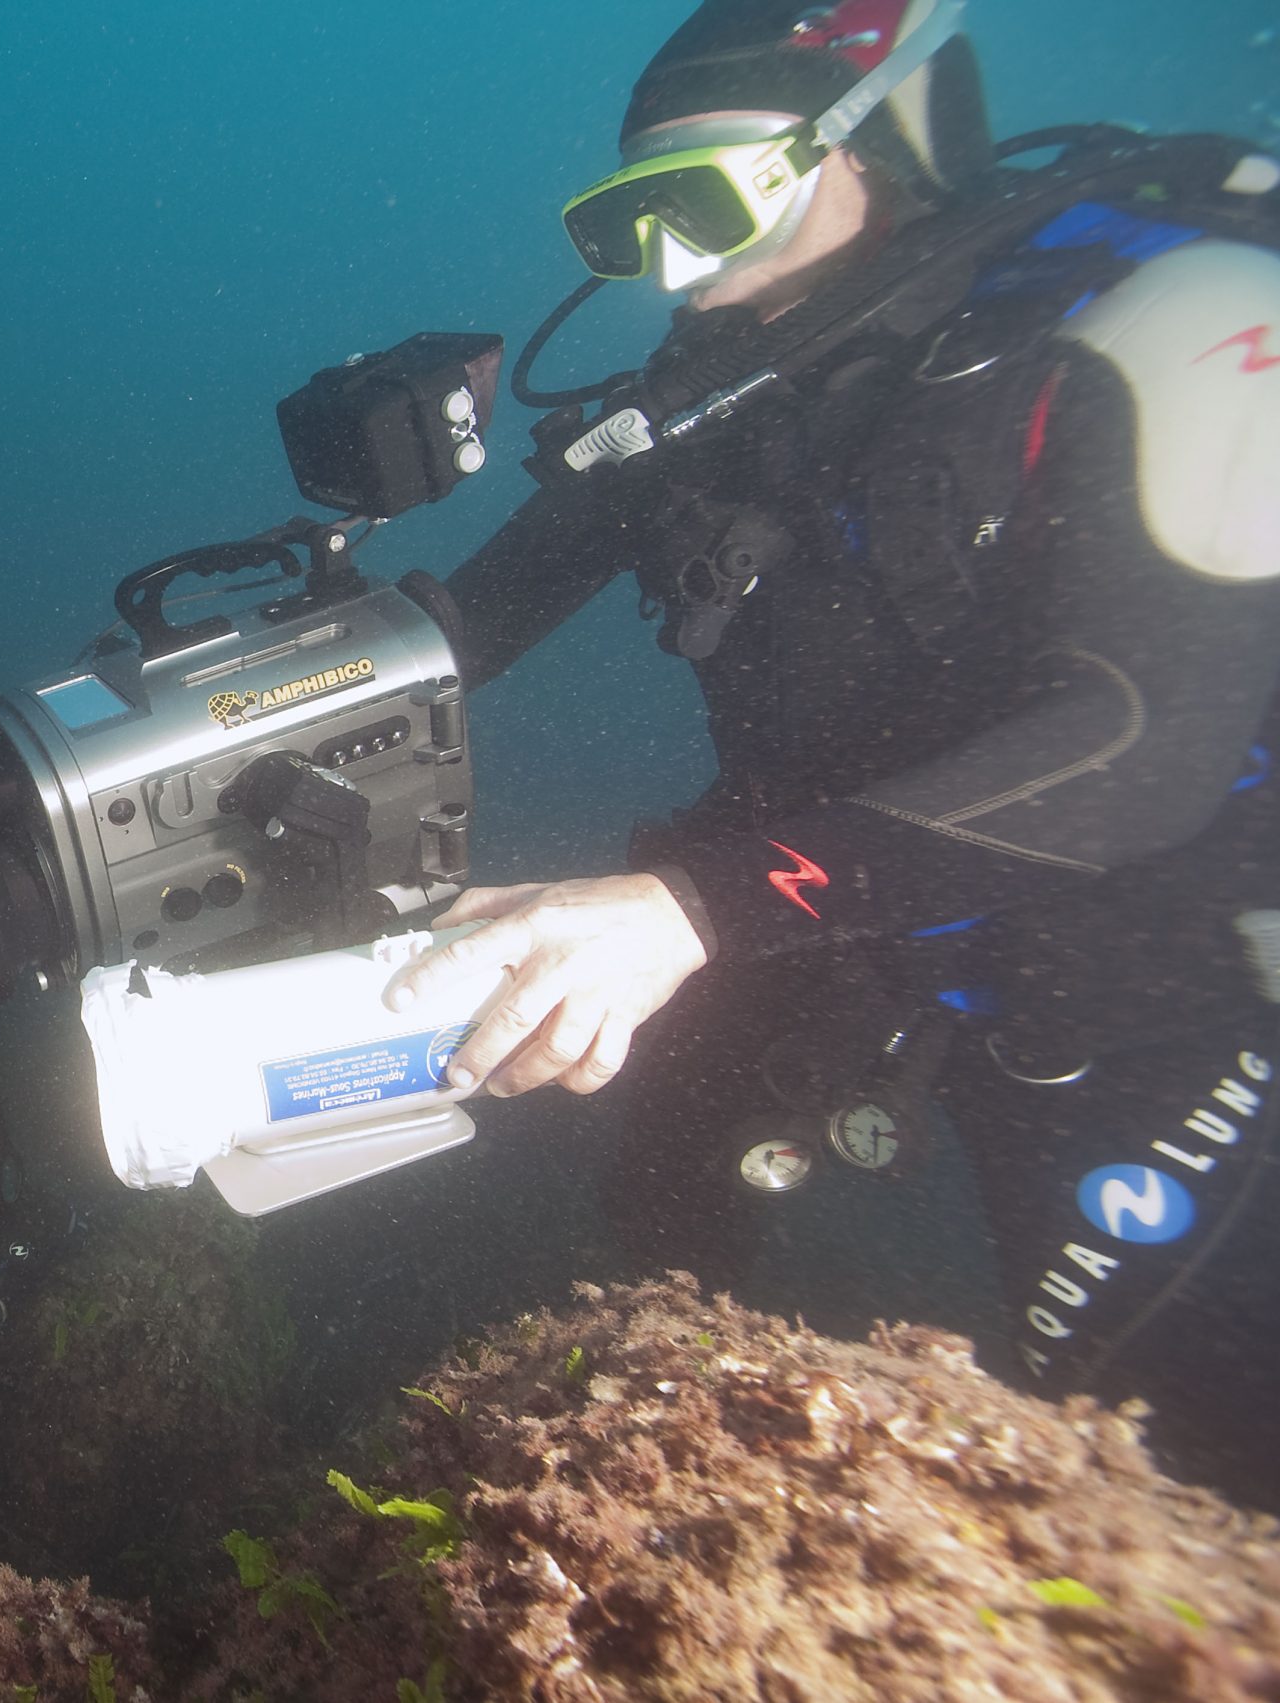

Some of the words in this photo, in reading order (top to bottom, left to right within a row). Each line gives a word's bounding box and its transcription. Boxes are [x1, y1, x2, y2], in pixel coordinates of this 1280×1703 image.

[260, 657, 375, 709] AMPHIBICO
[292, 1081, 351, 1100] Sous-Marines
[352, 1069, 406, 1087] Applications
[1021, 1242, 1121, 1378] AQUA
[1150, 1050, 1271, 1173] LUNG
